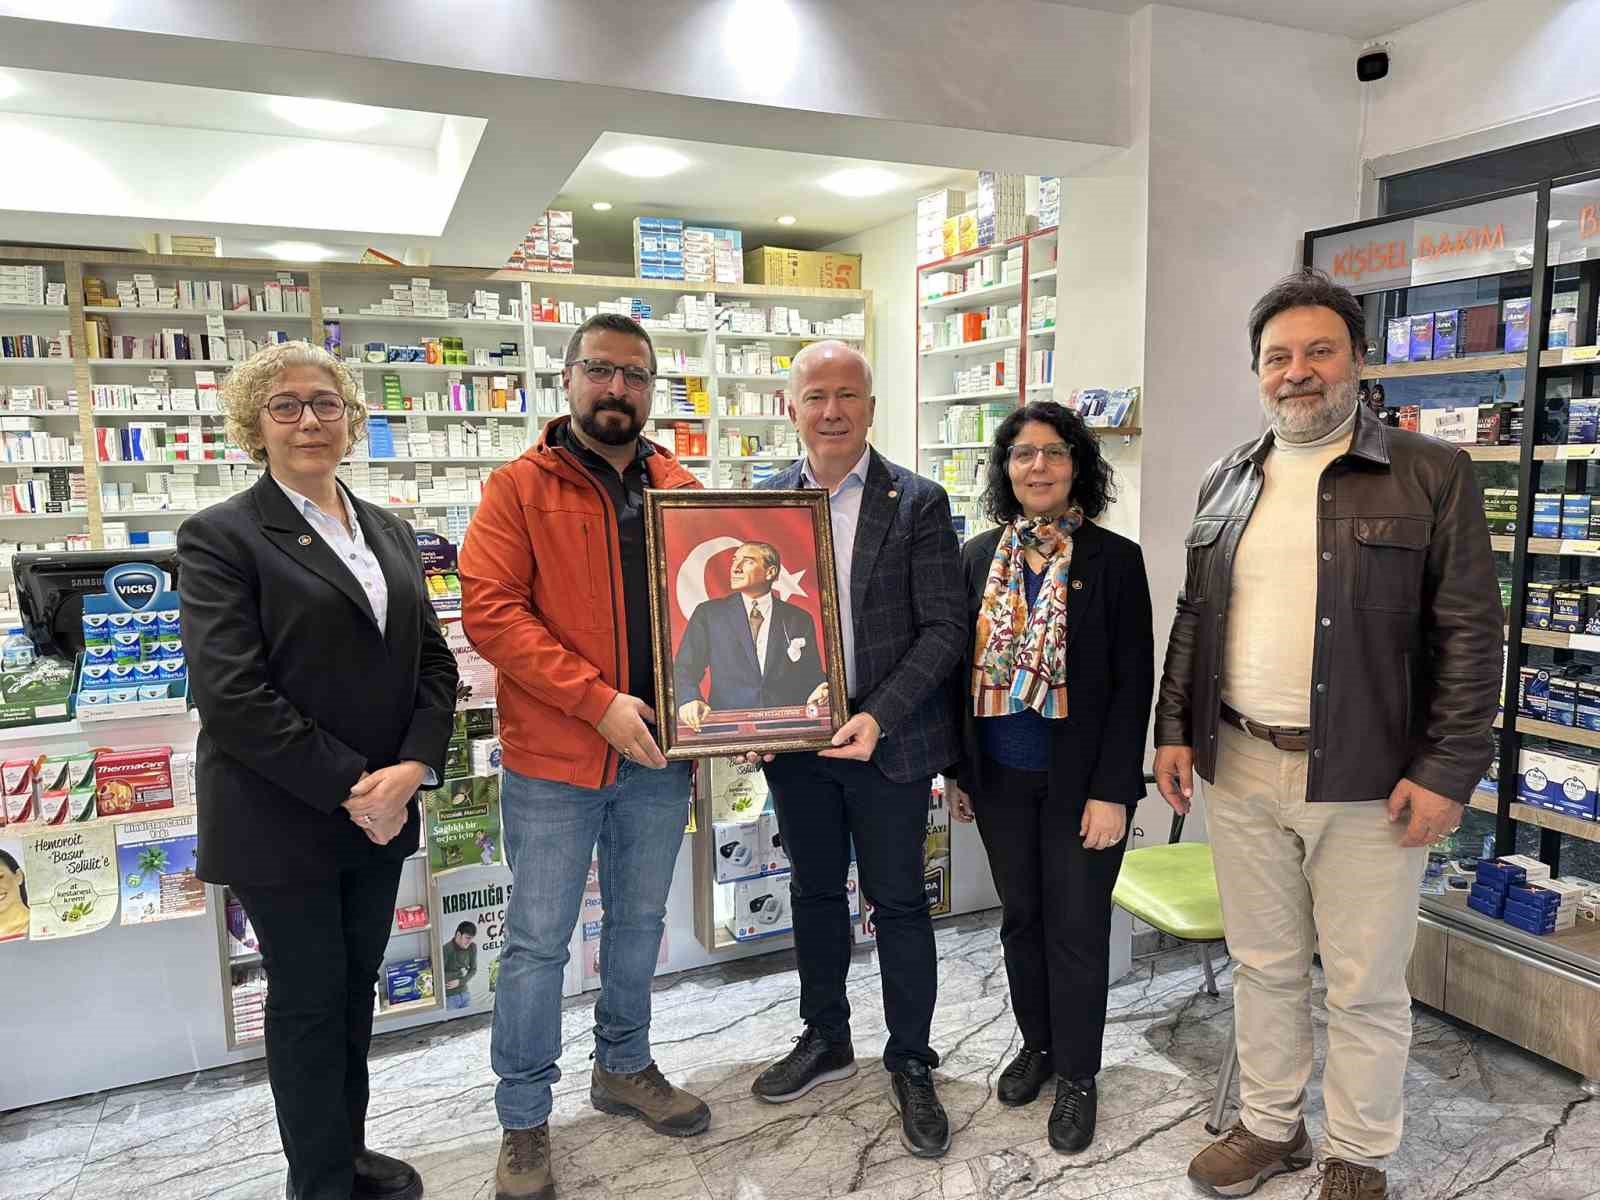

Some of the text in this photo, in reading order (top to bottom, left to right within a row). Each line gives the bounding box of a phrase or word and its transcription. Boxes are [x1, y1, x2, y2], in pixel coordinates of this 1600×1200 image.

[1417, 223, 1504, 259] BAKIM
[71, 576, 106, 588] SAMSU
[118, 584, 154, 595] VICKS
[97, 761, 166, 774] ThermaCare
[35, 832, 83, 852] Hemoroit
[52, 849, 84, 864] Basur
[442, 883, 504, 914] KABIZLIĞA
[478, 911, 496, 924] ACI
